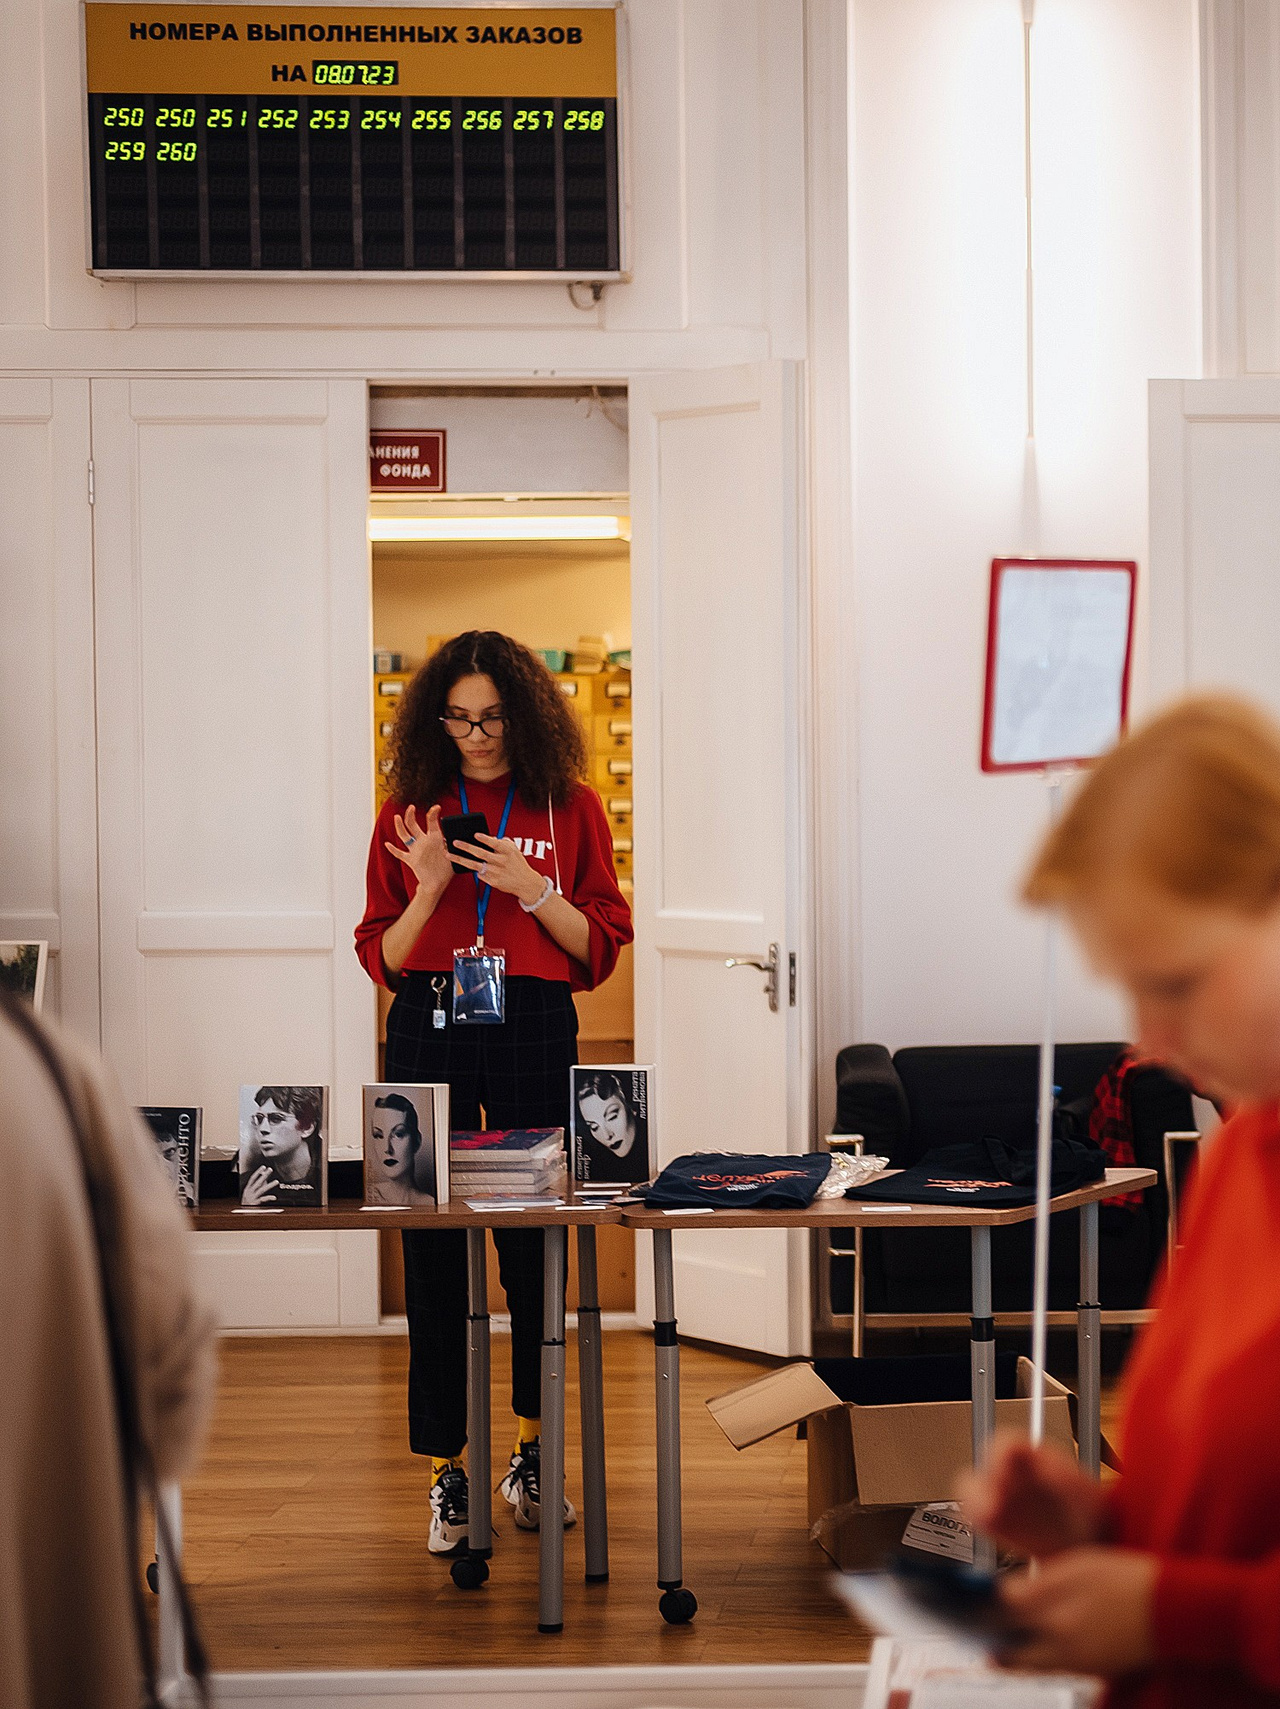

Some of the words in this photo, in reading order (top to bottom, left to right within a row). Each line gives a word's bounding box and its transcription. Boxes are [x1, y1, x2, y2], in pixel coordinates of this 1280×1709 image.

[129, 22, 239, 41] НОМЕРА
[247, 24, 459, 44] ВЫПОЛНЕННЫХ
[465, 26, 583, 45] ЗАКАЗОВ
[271, 64, 307, 83] НА
[103, 107, 145, 127] 250
[155, 108, 196, 128] 250
[206, 108, 248, 128] 251
[257, 108, 299, 129] 252
[309, 109, 351, 130] 253
[360, 110, 402, 130] 254
[411, 109, 452, 130] 255
[462, 110, 503, 131] 256
[512, 110, 555, 131] 257
[563, 110, 605, 131] 258
[104, 141, 146, 161] 259
[156, 142, 198, 162] 260
[379, 463, 432, 480] ФОНДА
